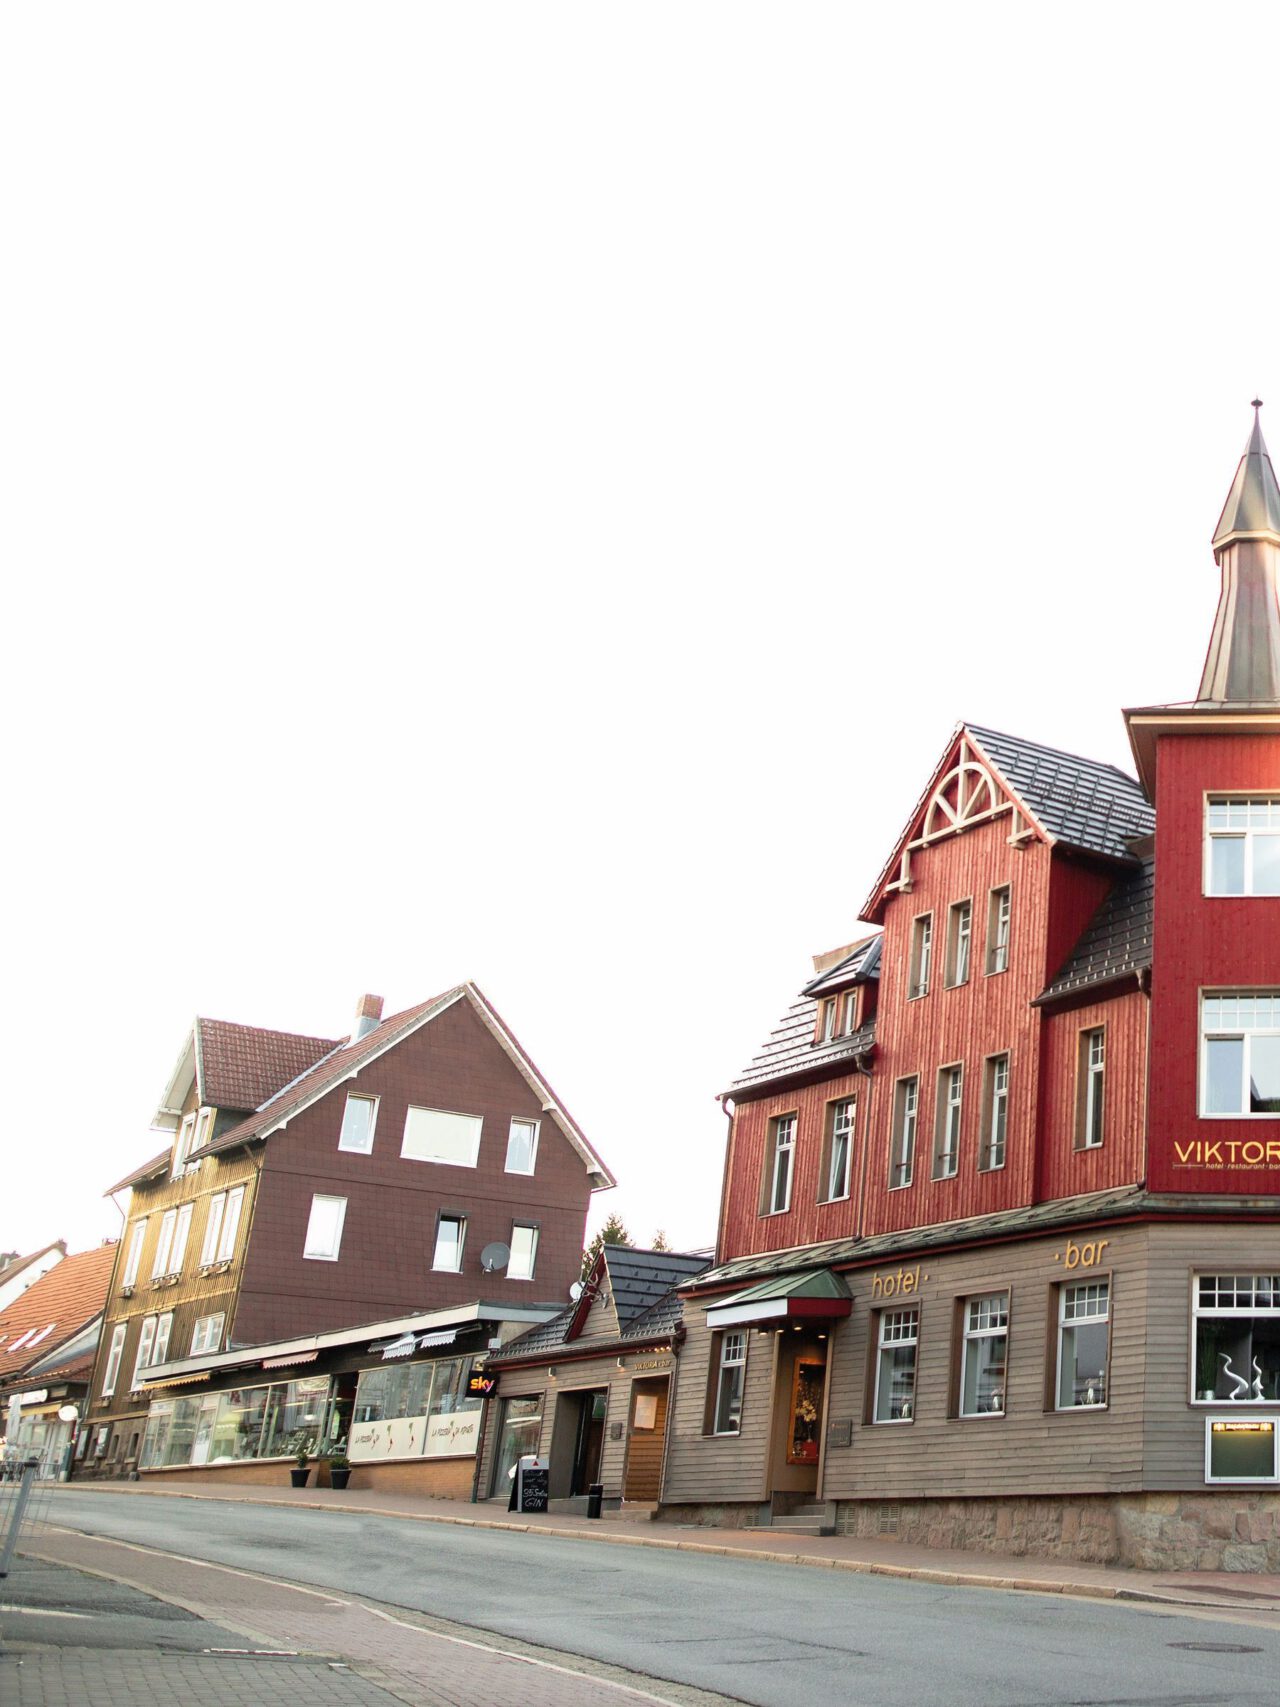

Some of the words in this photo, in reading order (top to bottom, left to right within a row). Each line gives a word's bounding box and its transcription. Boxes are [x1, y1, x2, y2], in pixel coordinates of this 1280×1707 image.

[872, 1265, 921, 1298] hotel
[1064, 1240, 1109, 1269] bar
[470, 1376, 495, 1392] sky
